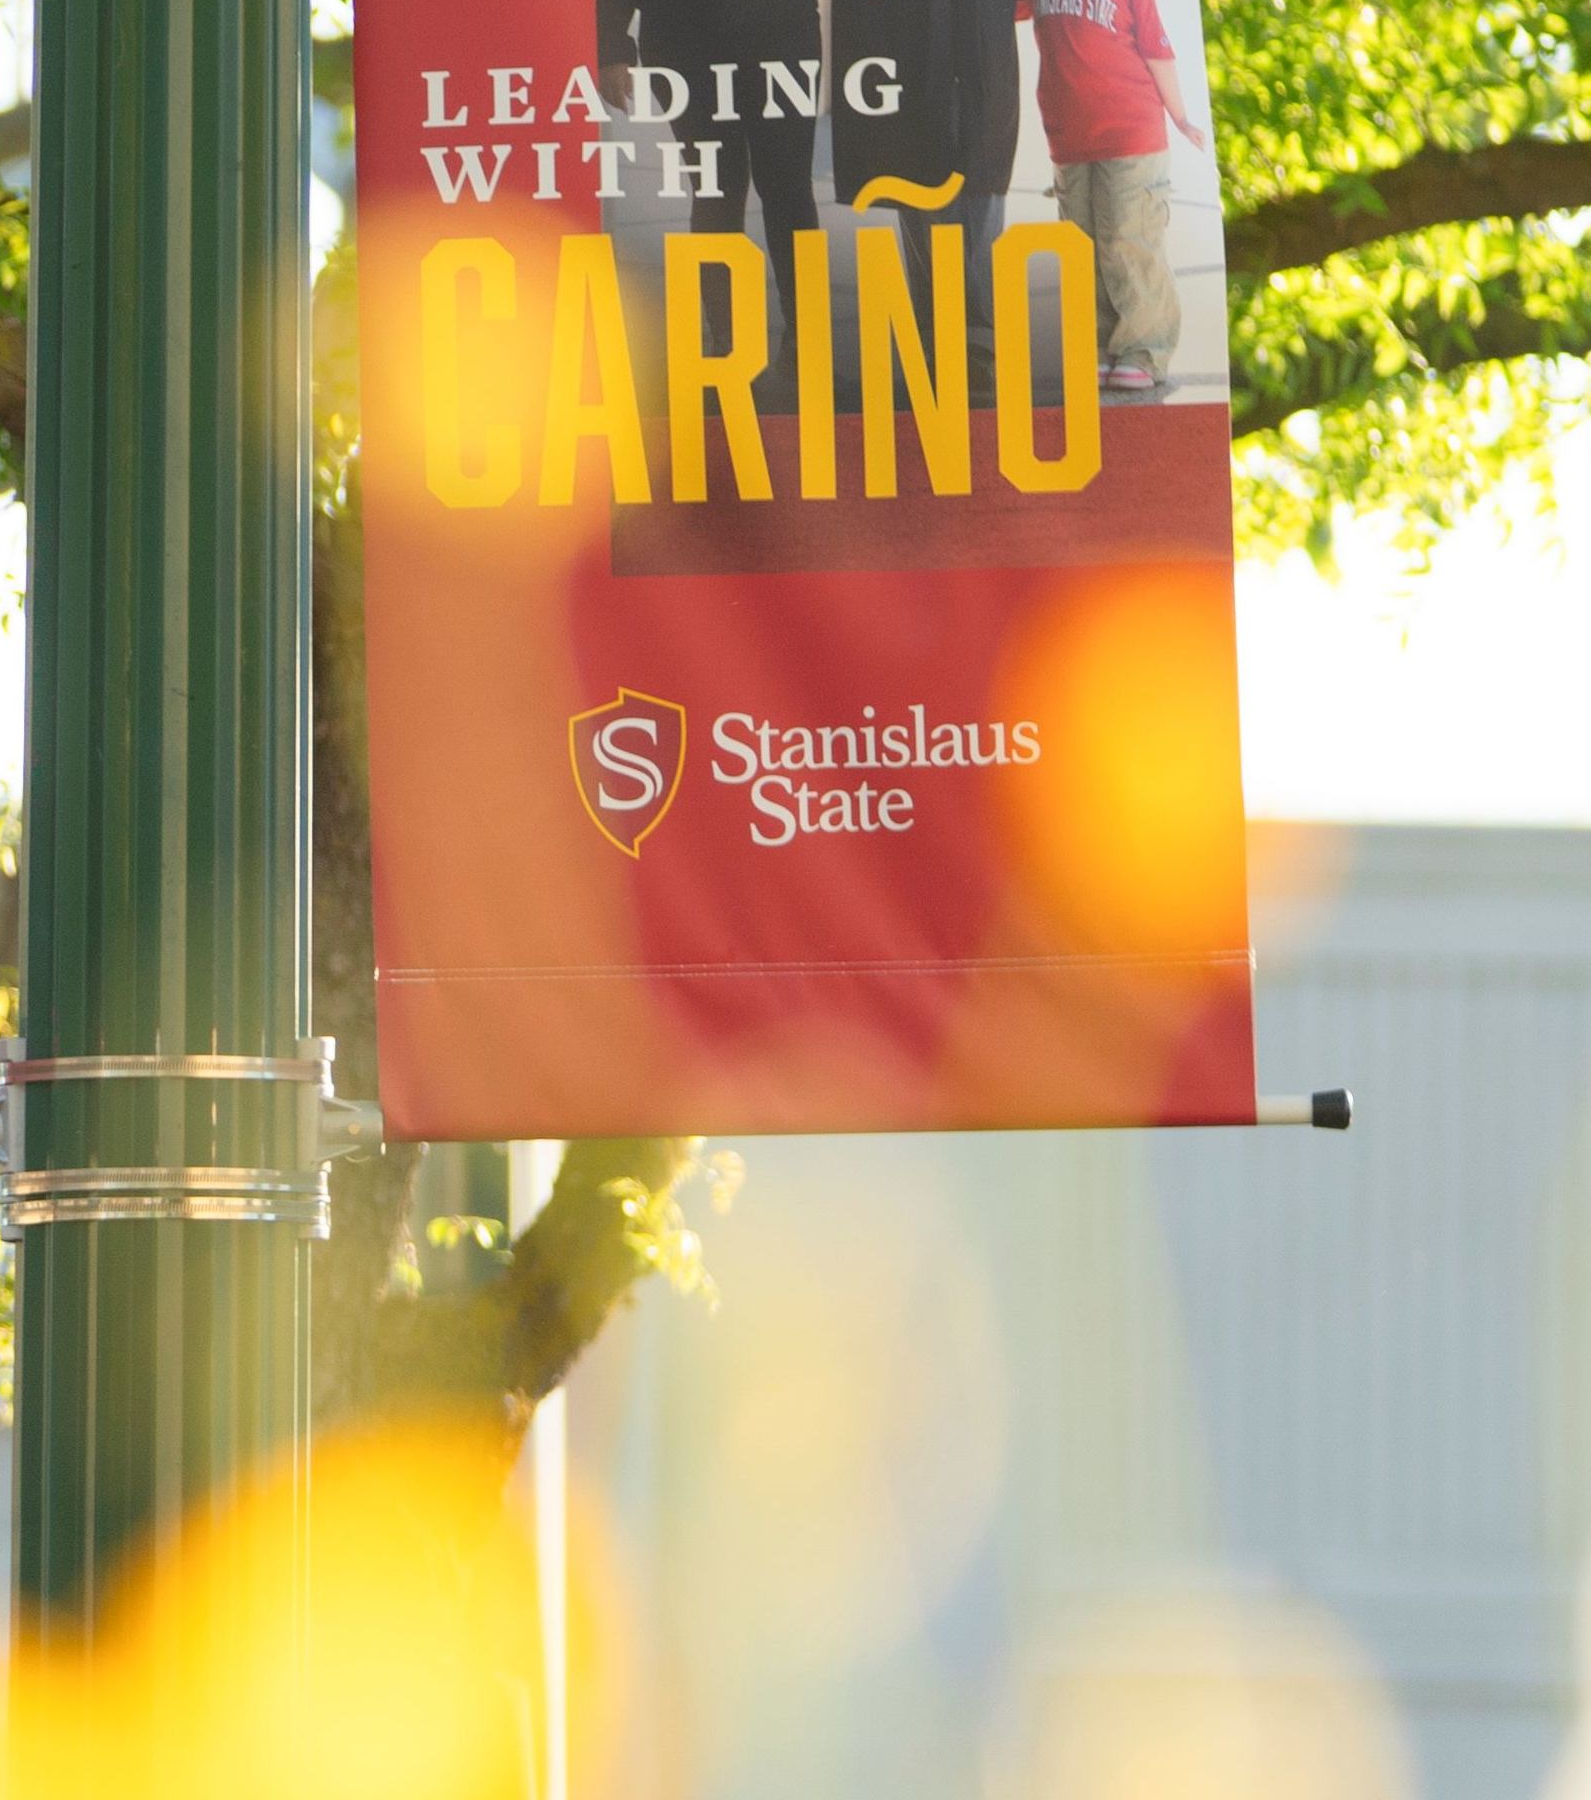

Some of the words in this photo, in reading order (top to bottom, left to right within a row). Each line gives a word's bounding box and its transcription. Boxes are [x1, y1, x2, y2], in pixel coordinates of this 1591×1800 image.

[421, 57, 904, 129] LEADING
[420, 140, 724, 203] WITH
[420, 173, 1102, 508] CARIÑO
[593, 717, 663, 811] S
[712, 704, 1041, 784] Stanislaus
[750, 775, 914, 847] State
